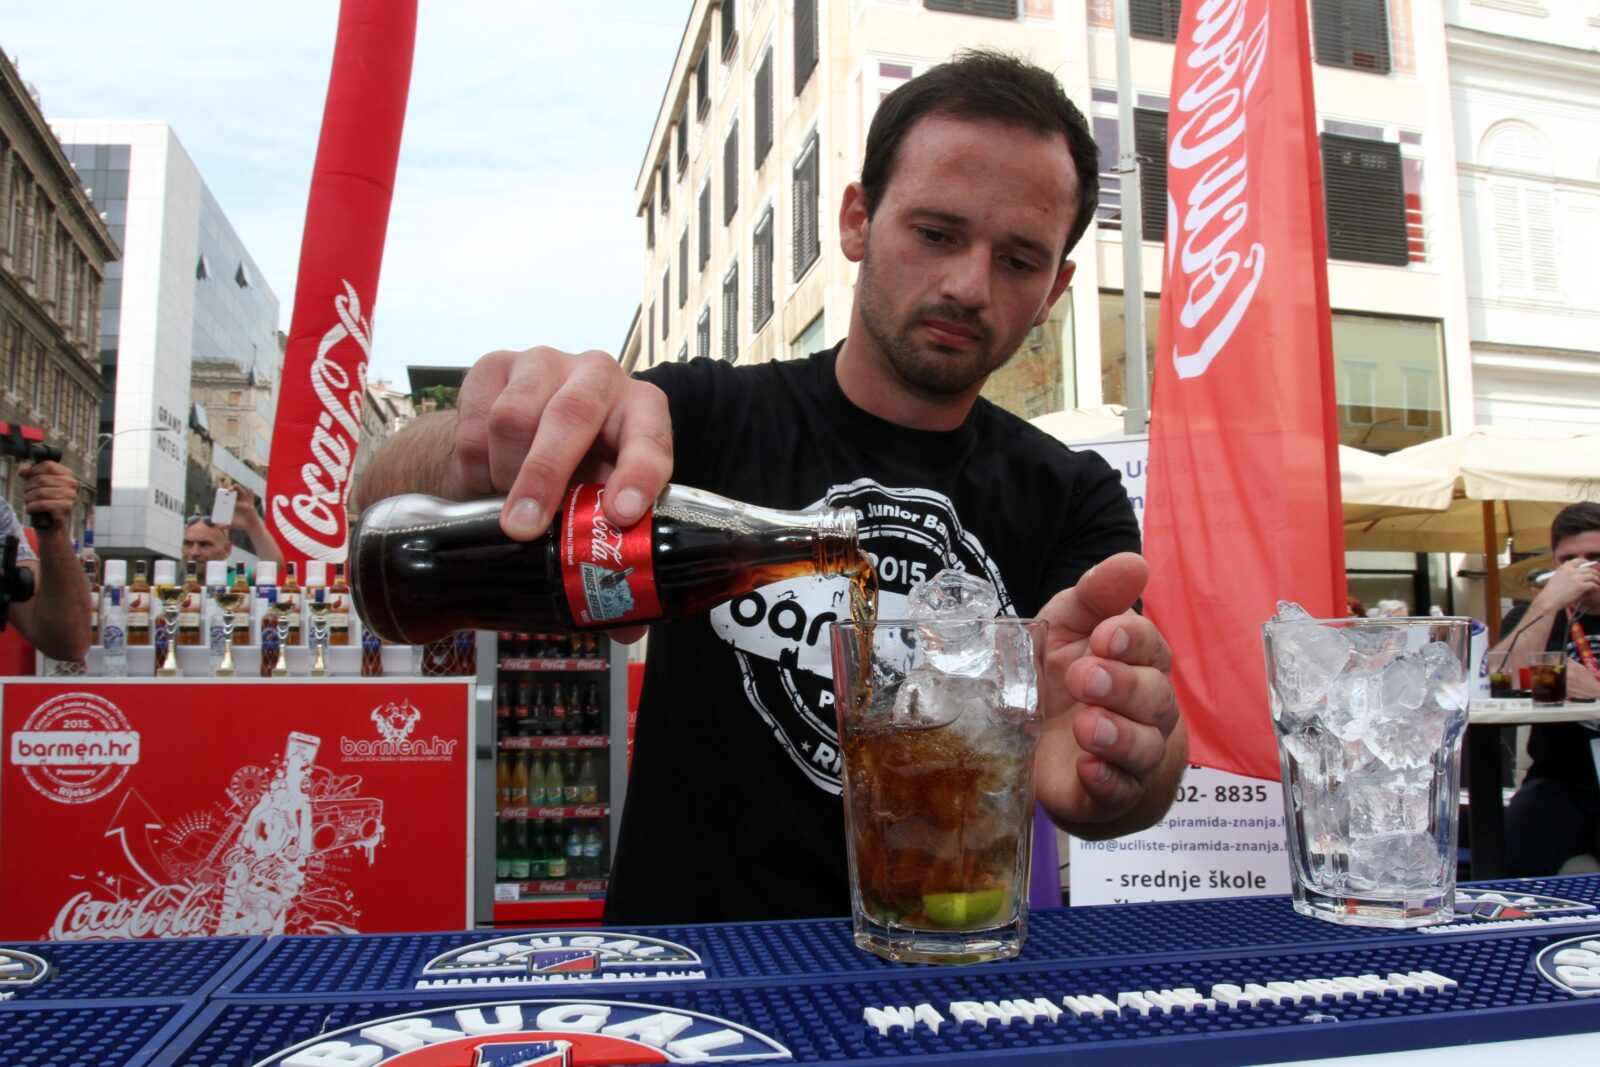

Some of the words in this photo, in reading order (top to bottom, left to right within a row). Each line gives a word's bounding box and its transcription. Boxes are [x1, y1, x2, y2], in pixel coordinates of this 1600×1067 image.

[158, 405, 181, 434] GRAND
[157, 433, 180, 461] HOTEL
[866, 503, 921, 524] Junior
[18, 739, 132, 757] barmen.hr
[340, 736, 458, 756] barmen.hr
[1215, 785, 1267, 802] 8835
[1120, 870, 1200, 892] srednje
[1209, 870, 1267, 889] škole
[51, 883, 216, 940] Coca-Cola
[950, 996, 1063, 1029] RUM
[1117, 988, 1217, 1016] THE
[1211, 971, 1458, 1008] CARIBBEAN
[279, 1004, 744, 1067] BRUGAL
